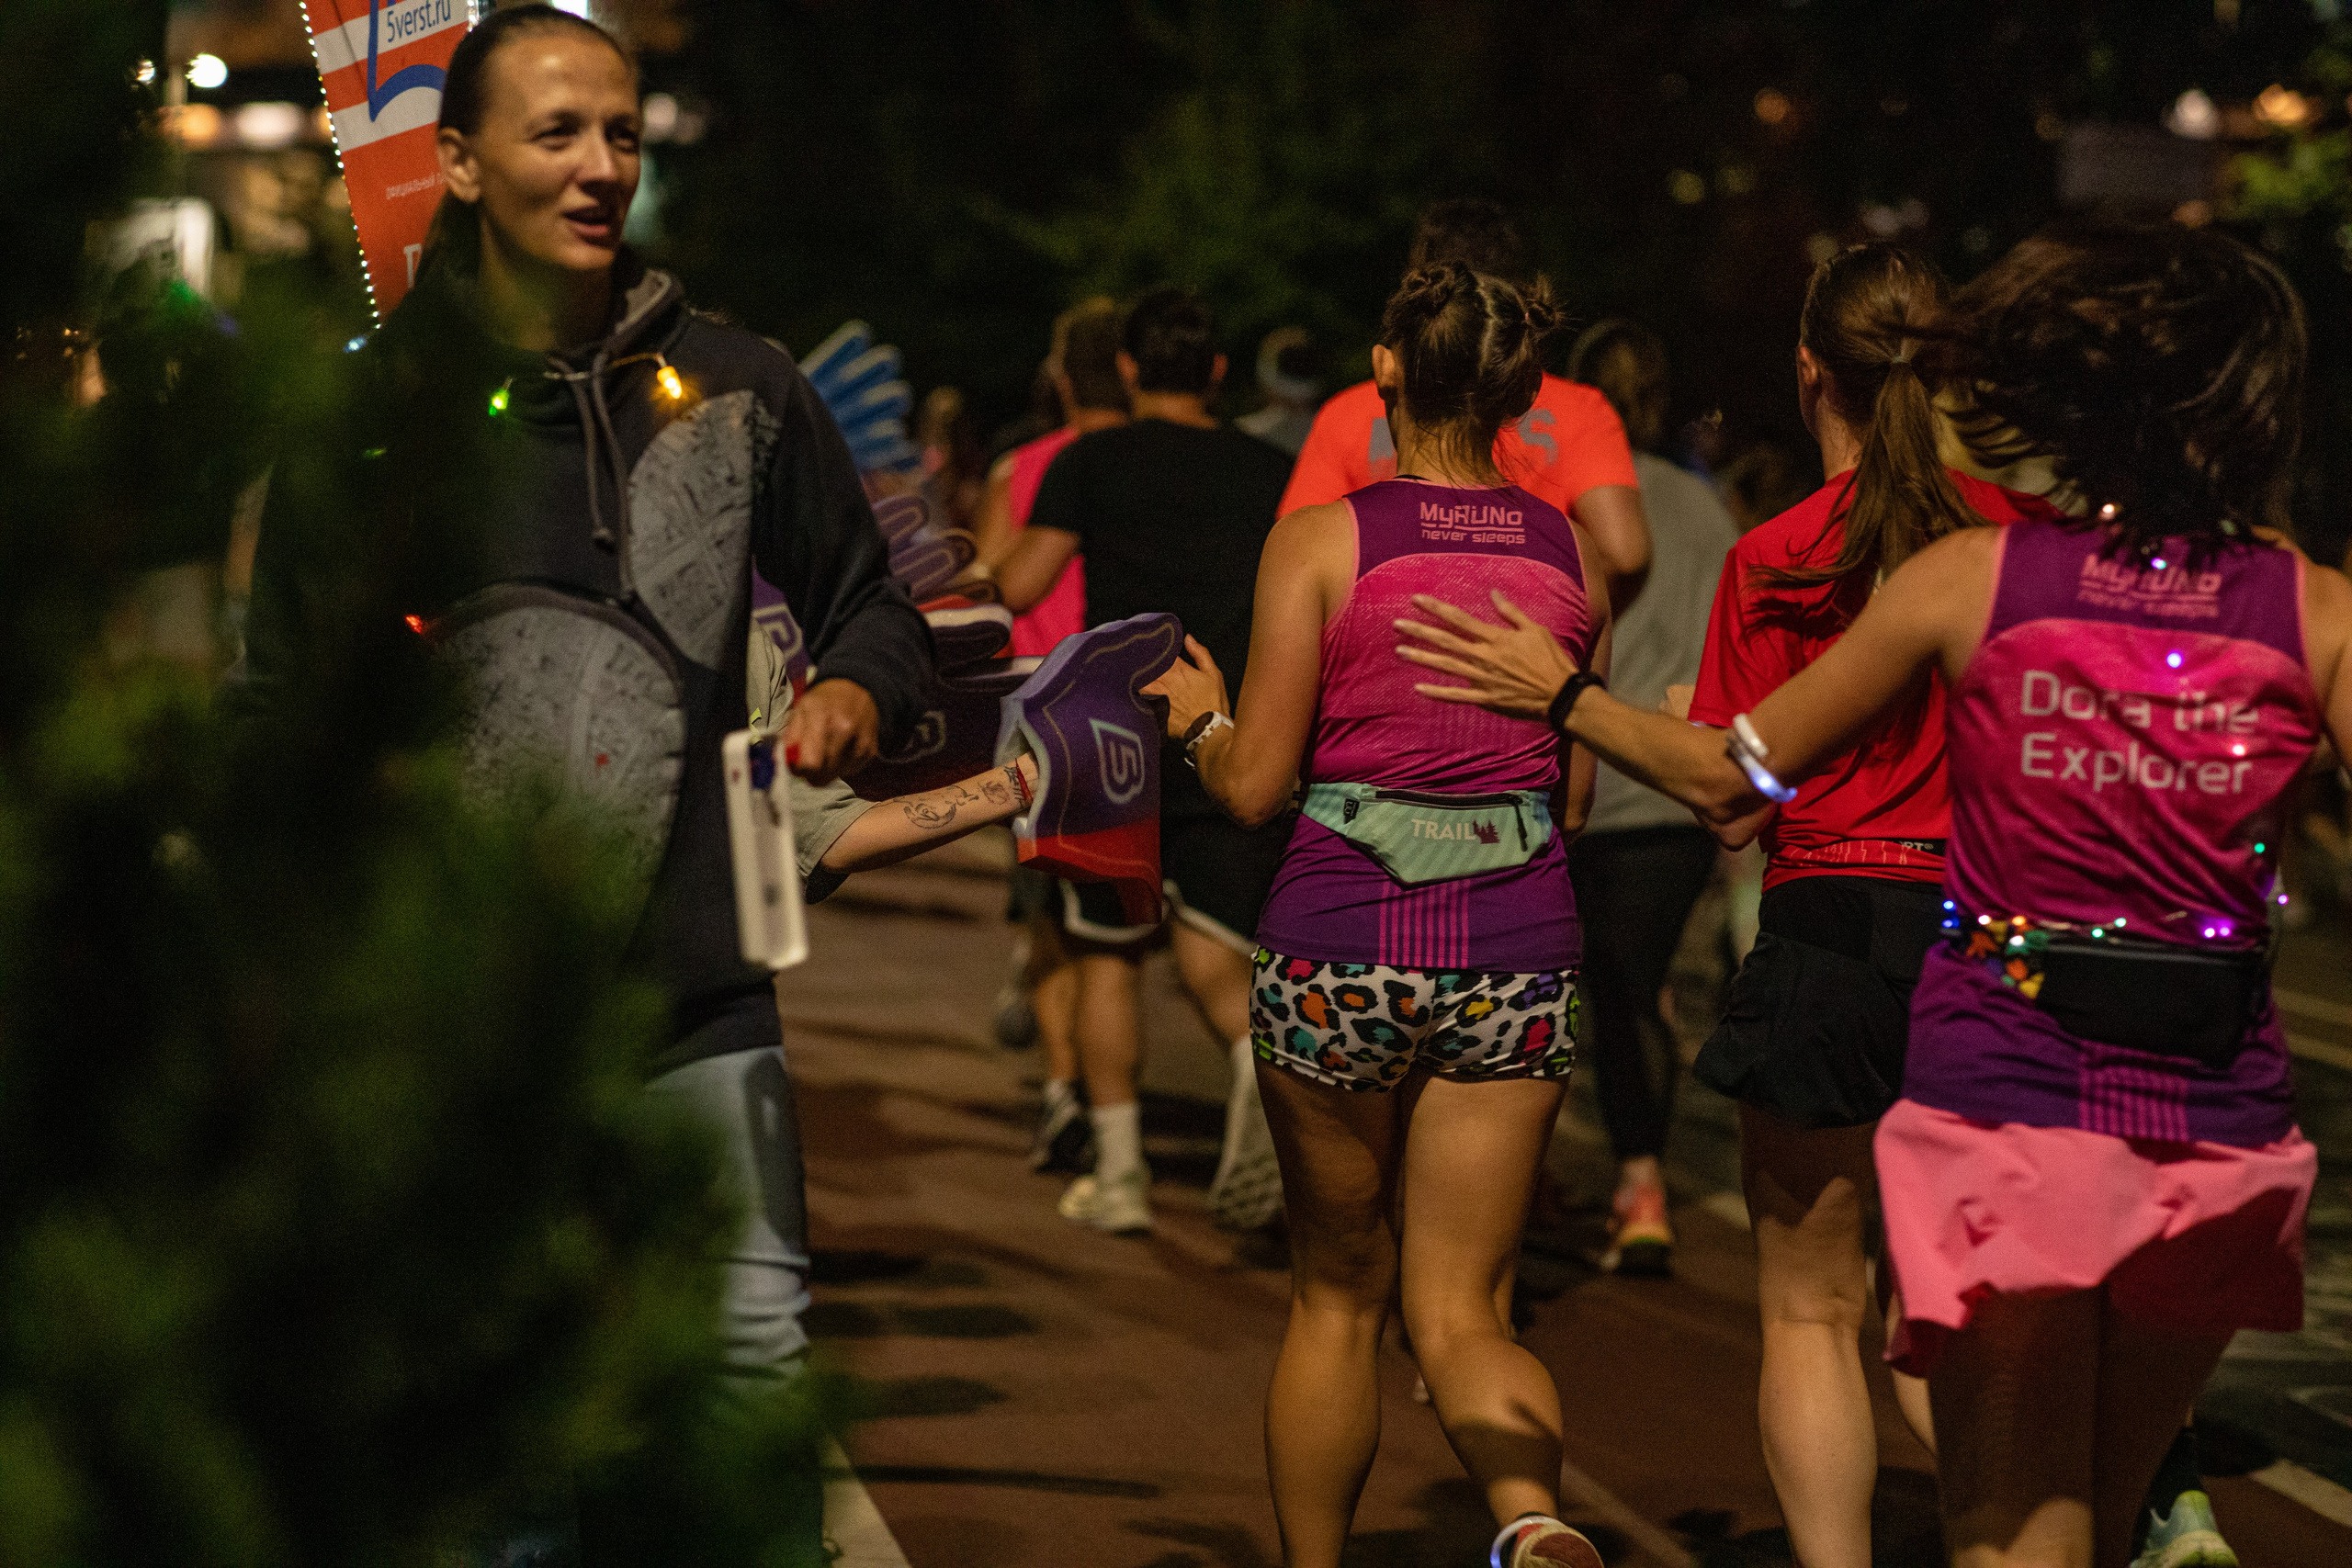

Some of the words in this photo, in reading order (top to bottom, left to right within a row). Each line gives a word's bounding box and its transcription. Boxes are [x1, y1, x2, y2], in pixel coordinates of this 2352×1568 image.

[387, 0, 450, 43] 5verst.ru
[1421, 529, 1468, 542] never
[1472, 532, 1526, 546] sleeps
[2022, 731, 2254, 795] Explorer
[1411, 818, 1476, 840] TRAIL
